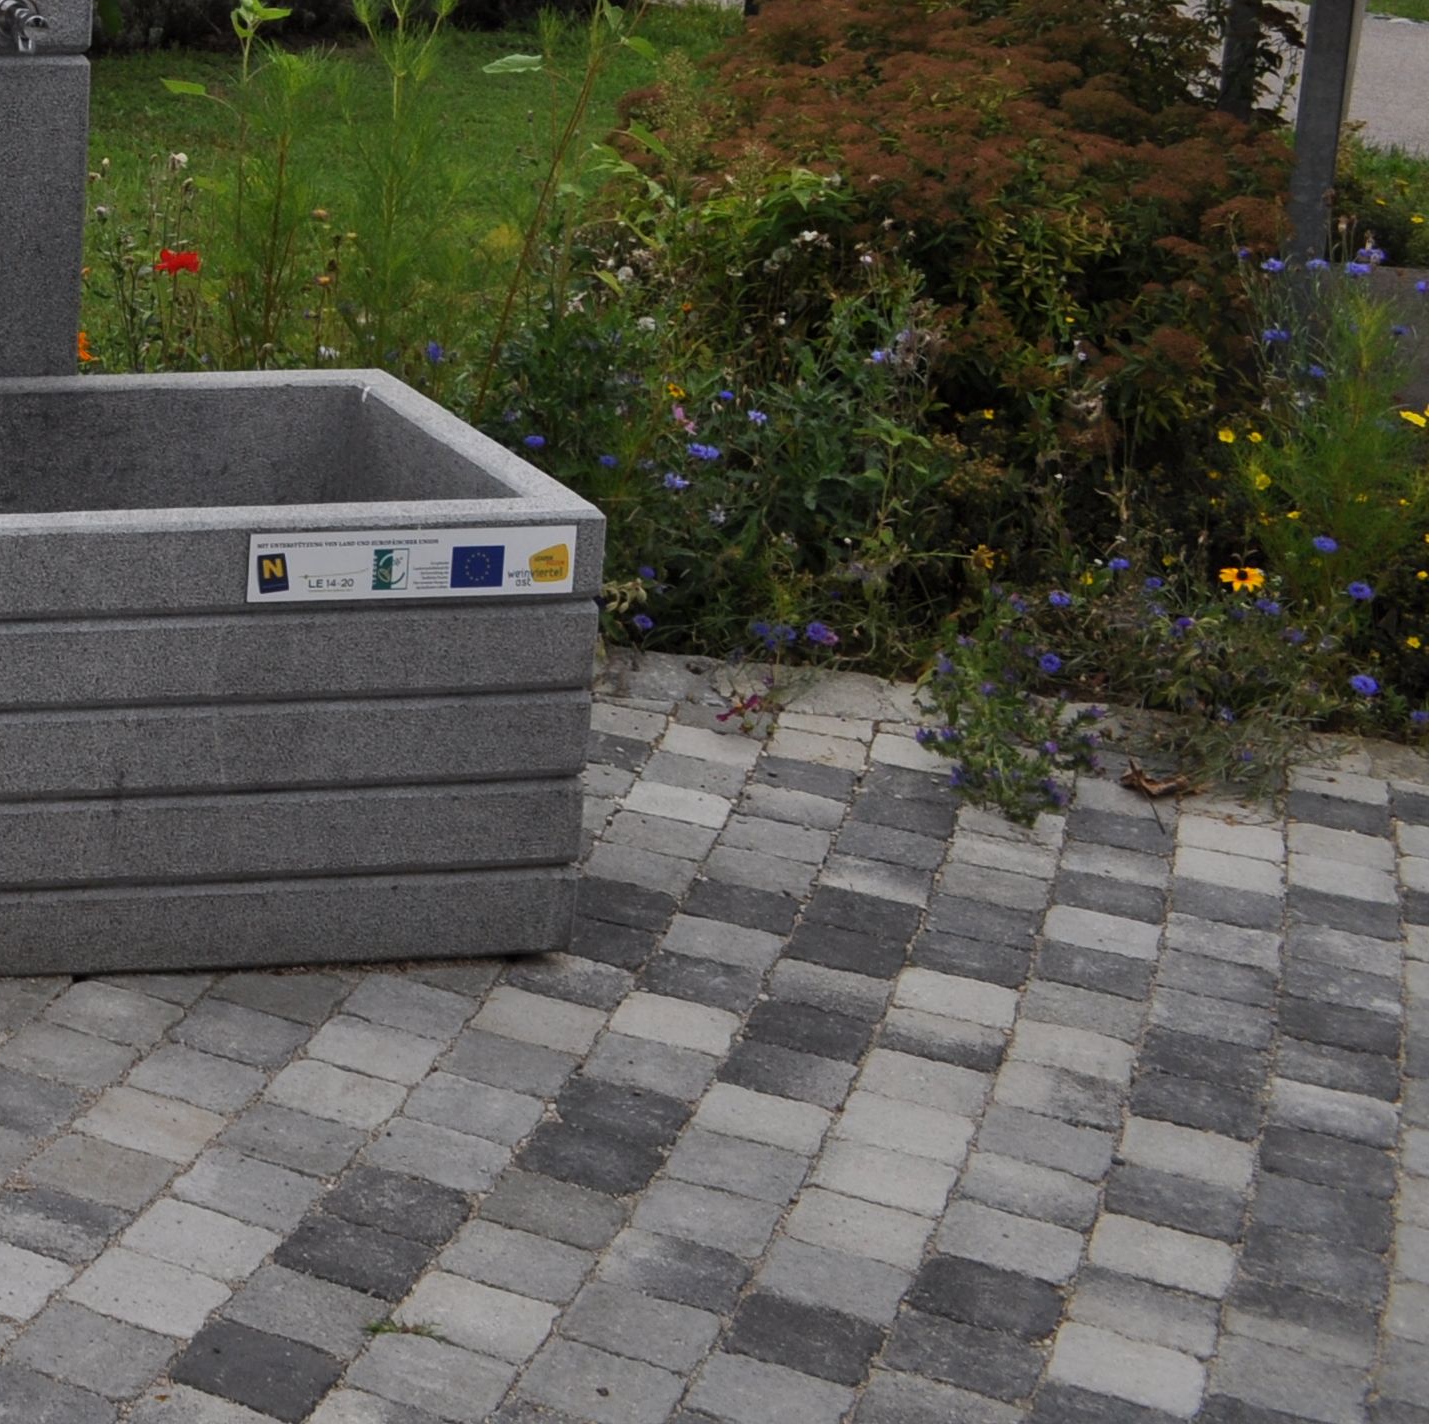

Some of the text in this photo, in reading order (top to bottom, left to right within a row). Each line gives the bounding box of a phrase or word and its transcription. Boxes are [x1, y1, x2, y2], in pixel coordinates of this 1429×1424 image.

[262, 558, 284, 579] N
[508, 566, 563, 579] weinviertel
[308, 579, 323, 588] LE
[515, 577, 531, 587] ost
